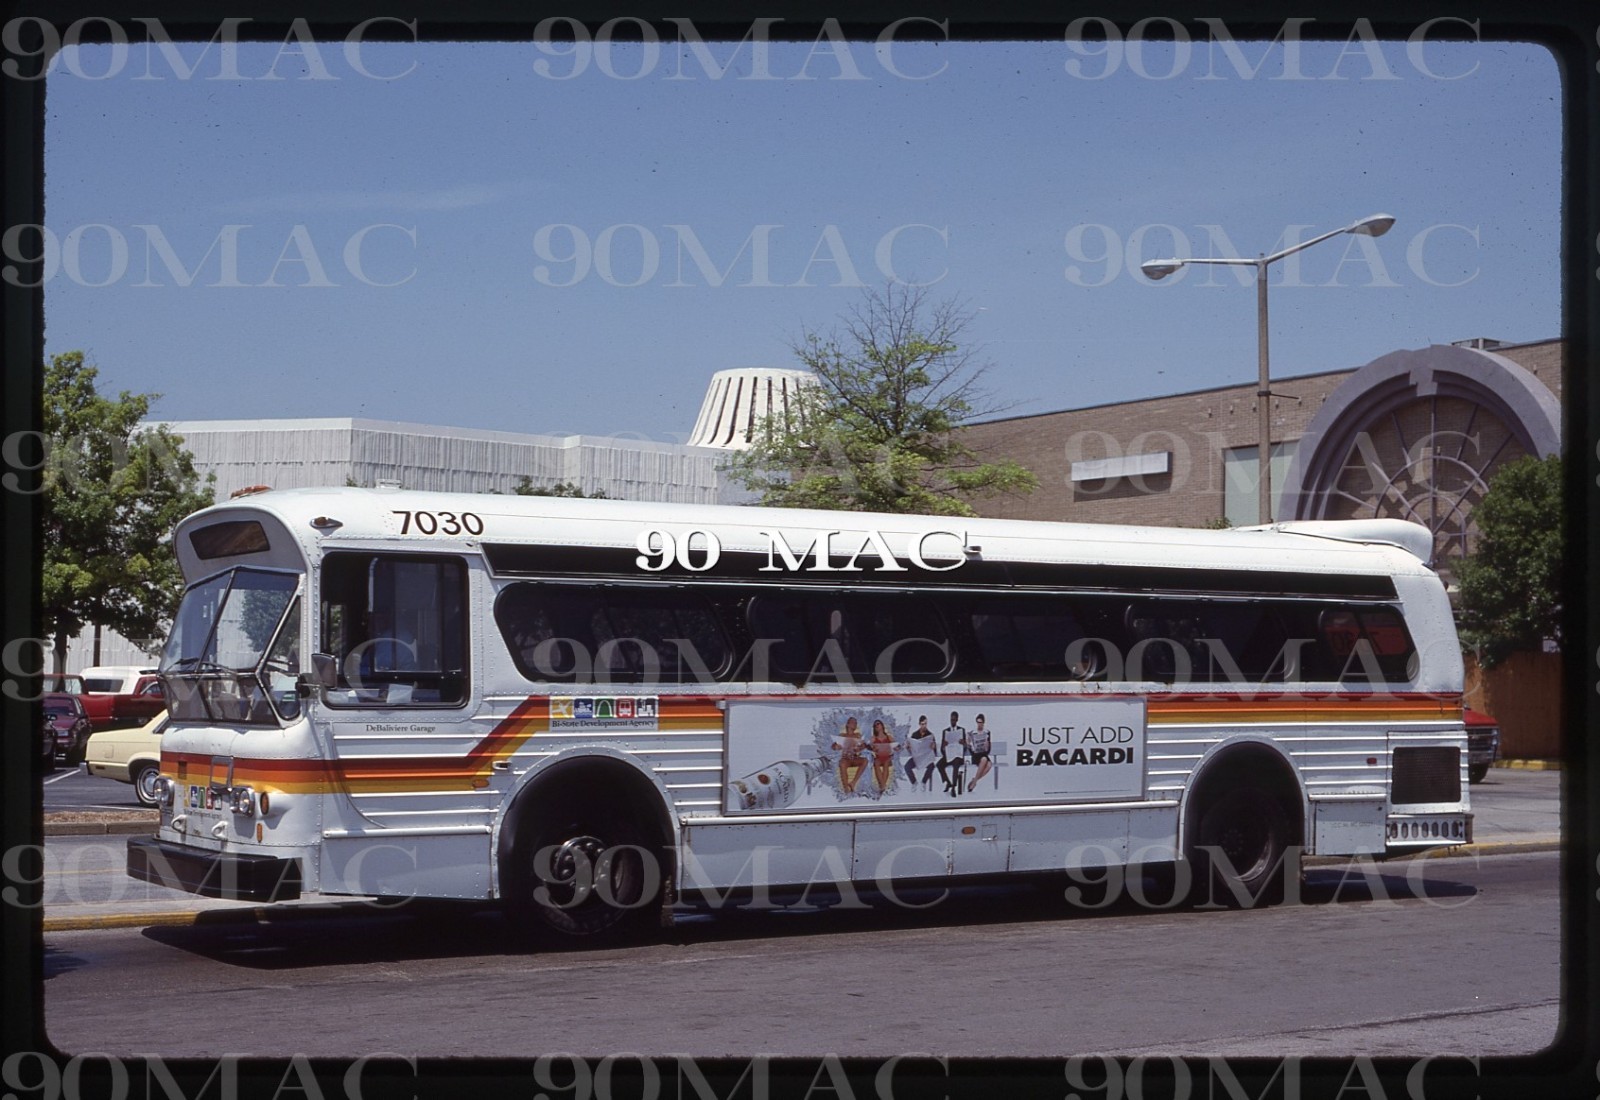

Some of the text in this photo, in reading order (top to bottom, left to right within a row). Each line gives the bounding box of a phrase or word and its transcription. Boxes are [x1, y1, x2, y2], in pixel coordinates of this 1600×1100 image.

[391, 511, 484, 536] 7030
[366, 724, 436, 733] DeBaliviere Garage
[552, 719, 656, 728] Bi-State Development Agency
[1016, 726, 1134, 747] JUST ADD
[1016, 747, 1134, 766] BACARDI
